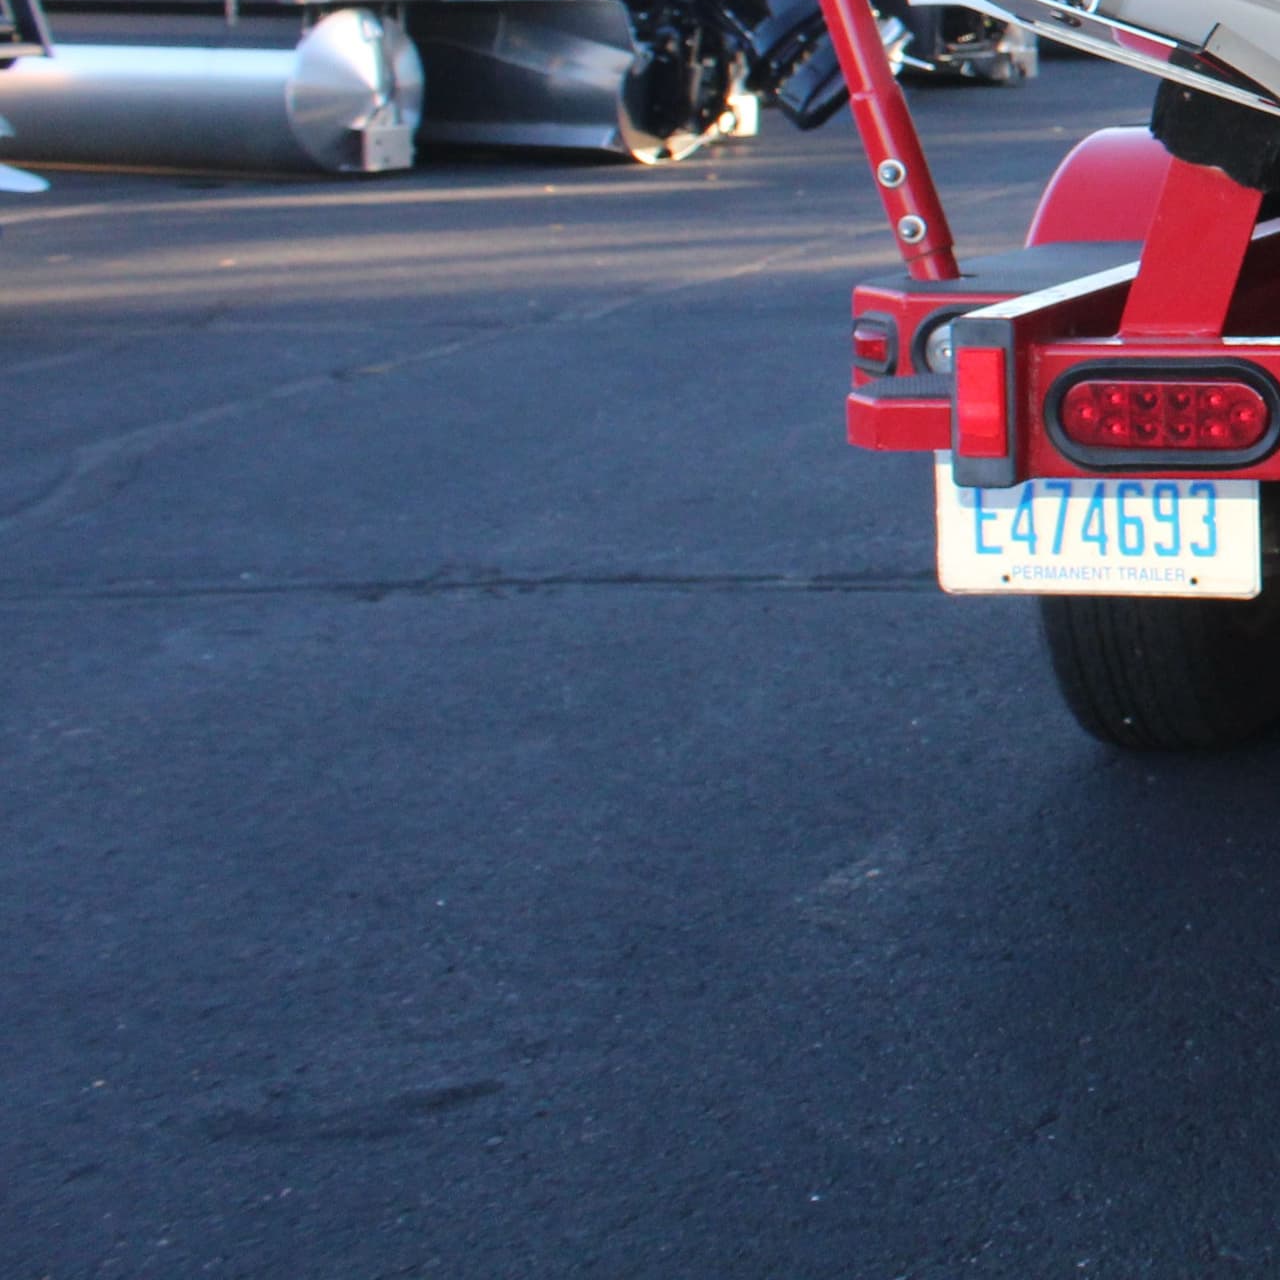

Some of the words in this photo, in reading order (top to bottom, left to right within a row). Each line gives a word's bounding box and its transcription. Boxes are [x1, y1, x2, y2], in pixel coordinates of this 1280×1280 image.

[974, 481, 1217, 557] E474693
[1012, 566, 1112, 580] PERMANENT
[1118, 568, 1185, 582] TRAILER
